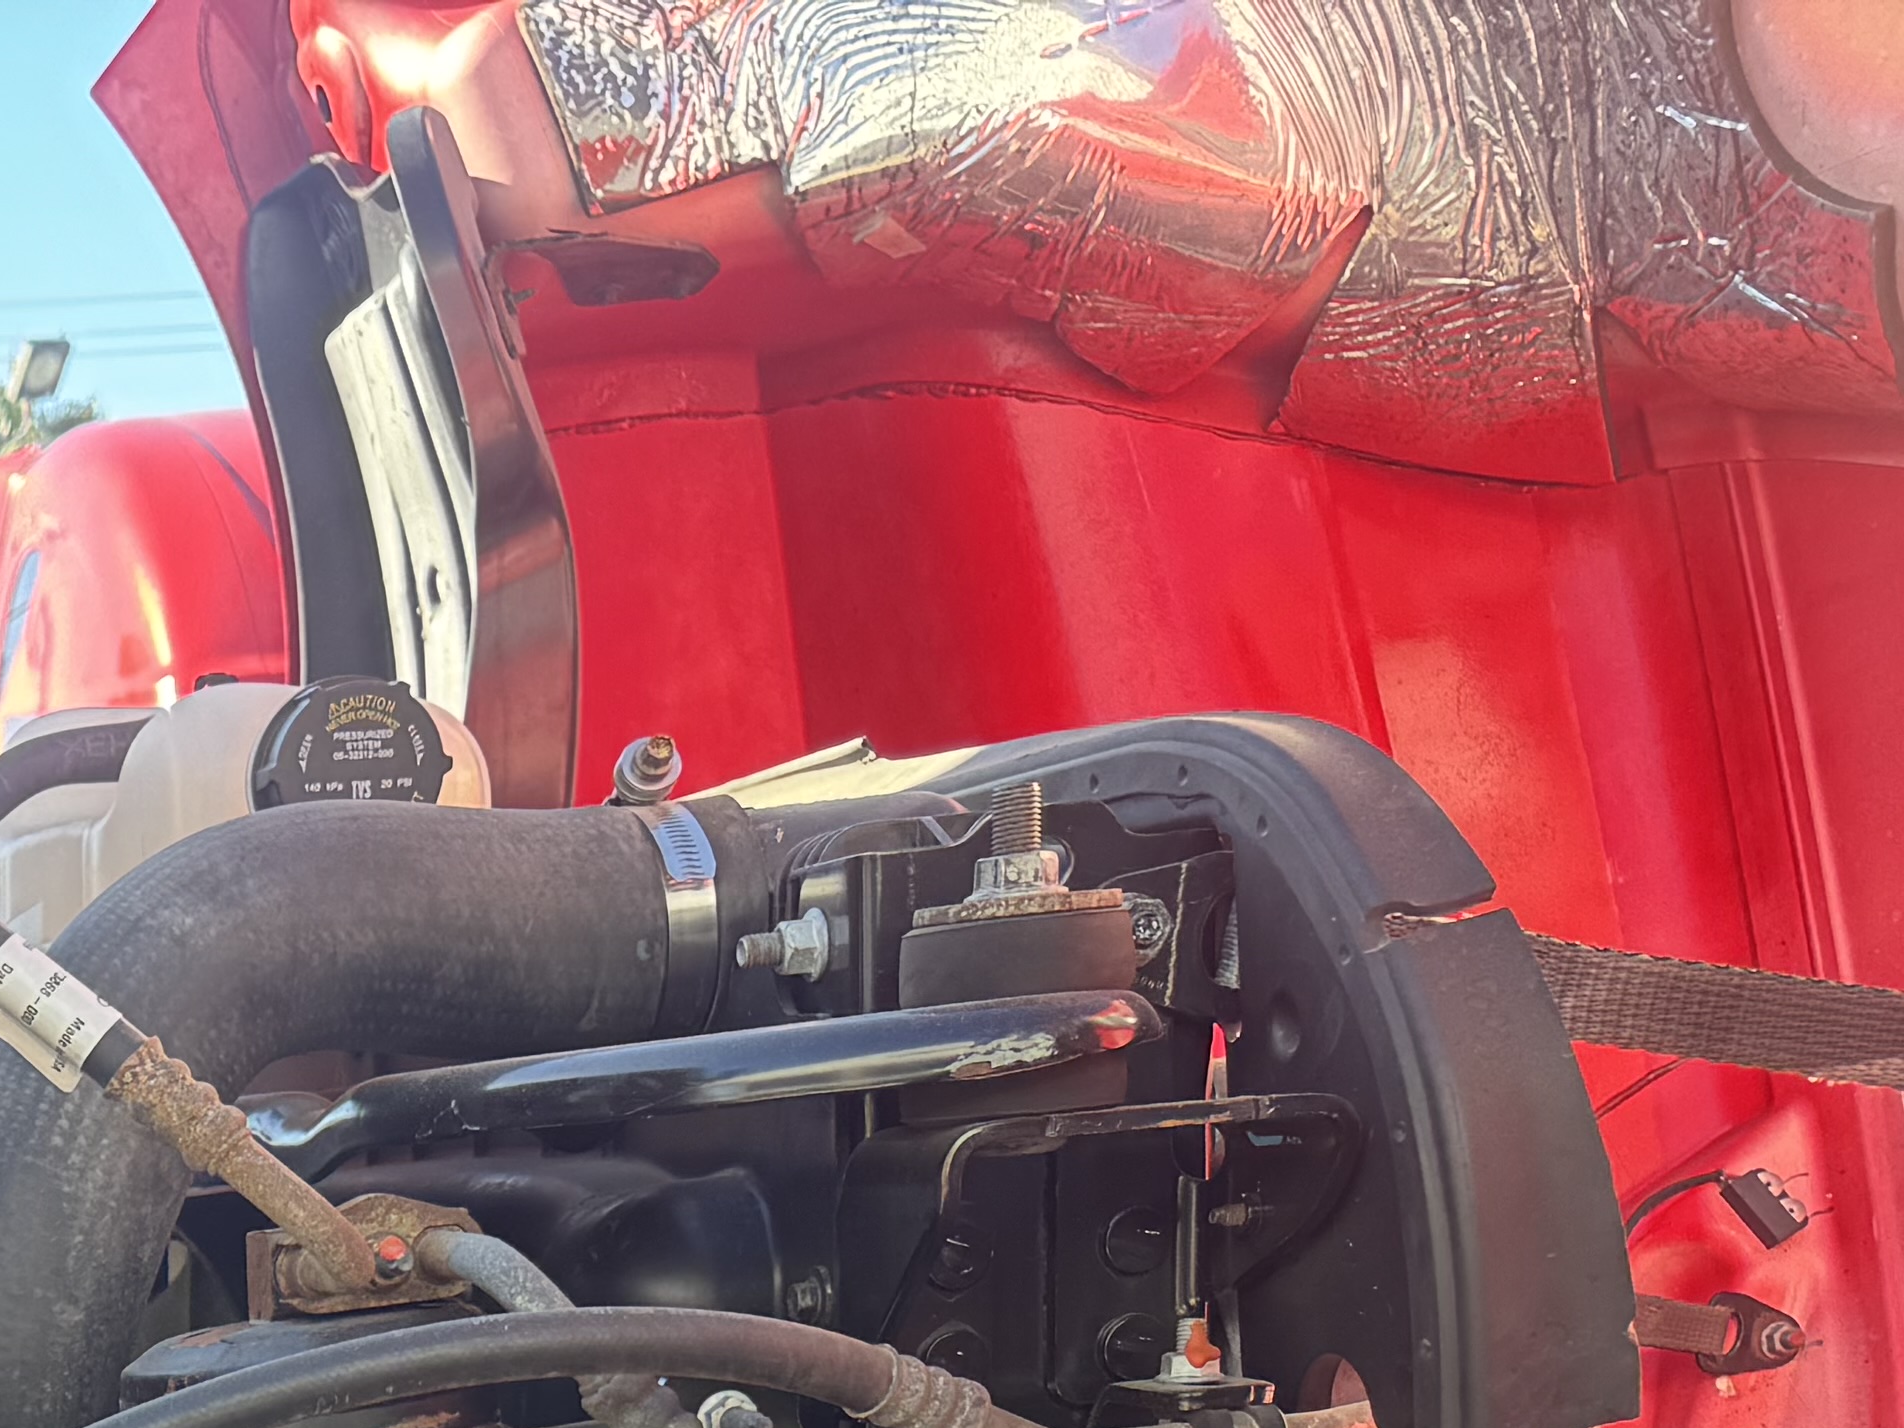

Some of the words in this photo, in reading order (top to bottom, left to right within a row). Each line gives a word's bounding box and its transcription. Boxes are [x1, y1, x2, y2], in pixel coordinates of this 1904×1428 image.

[340, 695, 395, 714] CAUTION
[333, 729, 394, 741] PRESSURIZED
[346, 741, 381, 750] SYSTEM
